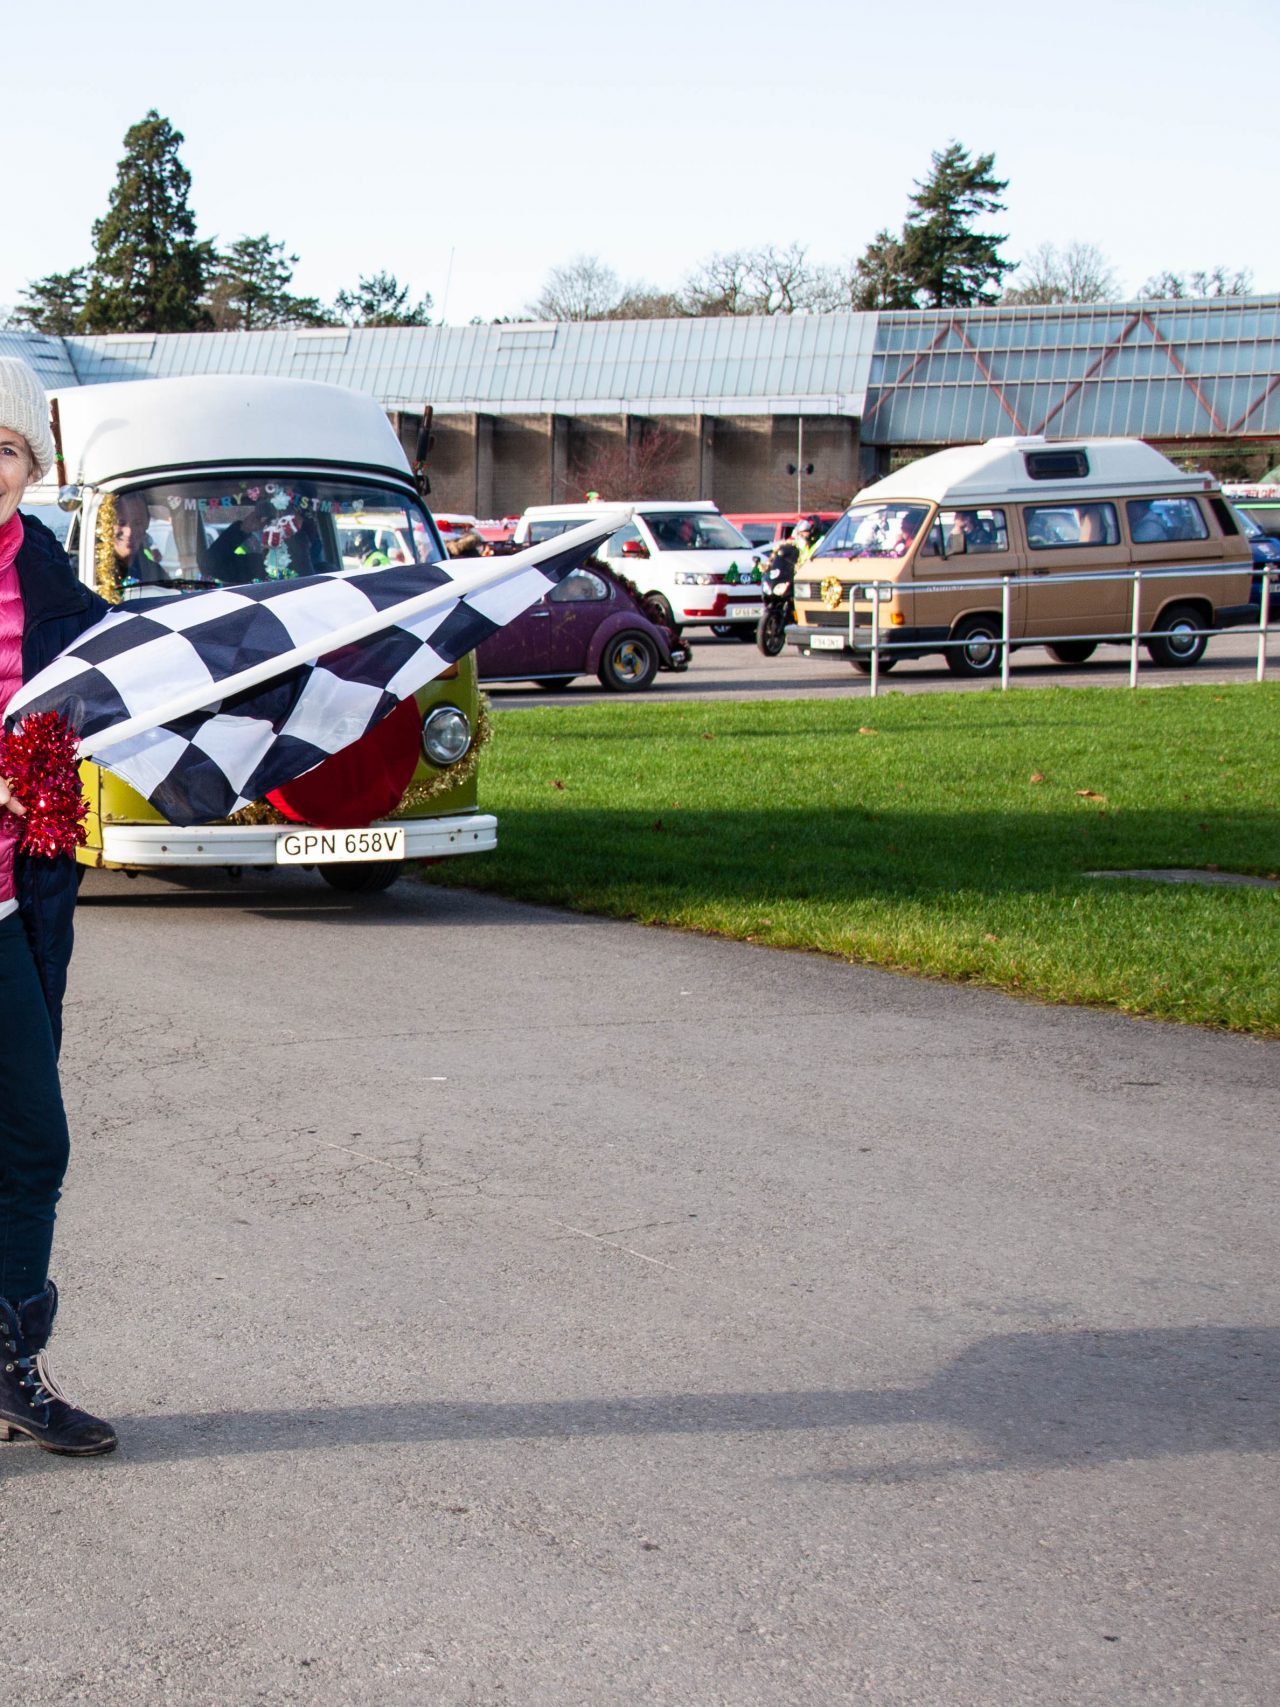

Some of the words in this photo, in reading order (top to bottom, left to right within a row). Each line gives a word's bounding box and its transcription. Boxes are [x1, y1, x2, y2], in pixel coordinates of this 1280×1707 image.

[183, 492, 244, 513] MERRY
[284, 835, 335, 856] GPN
[345, 832, 398, 853] 658V
